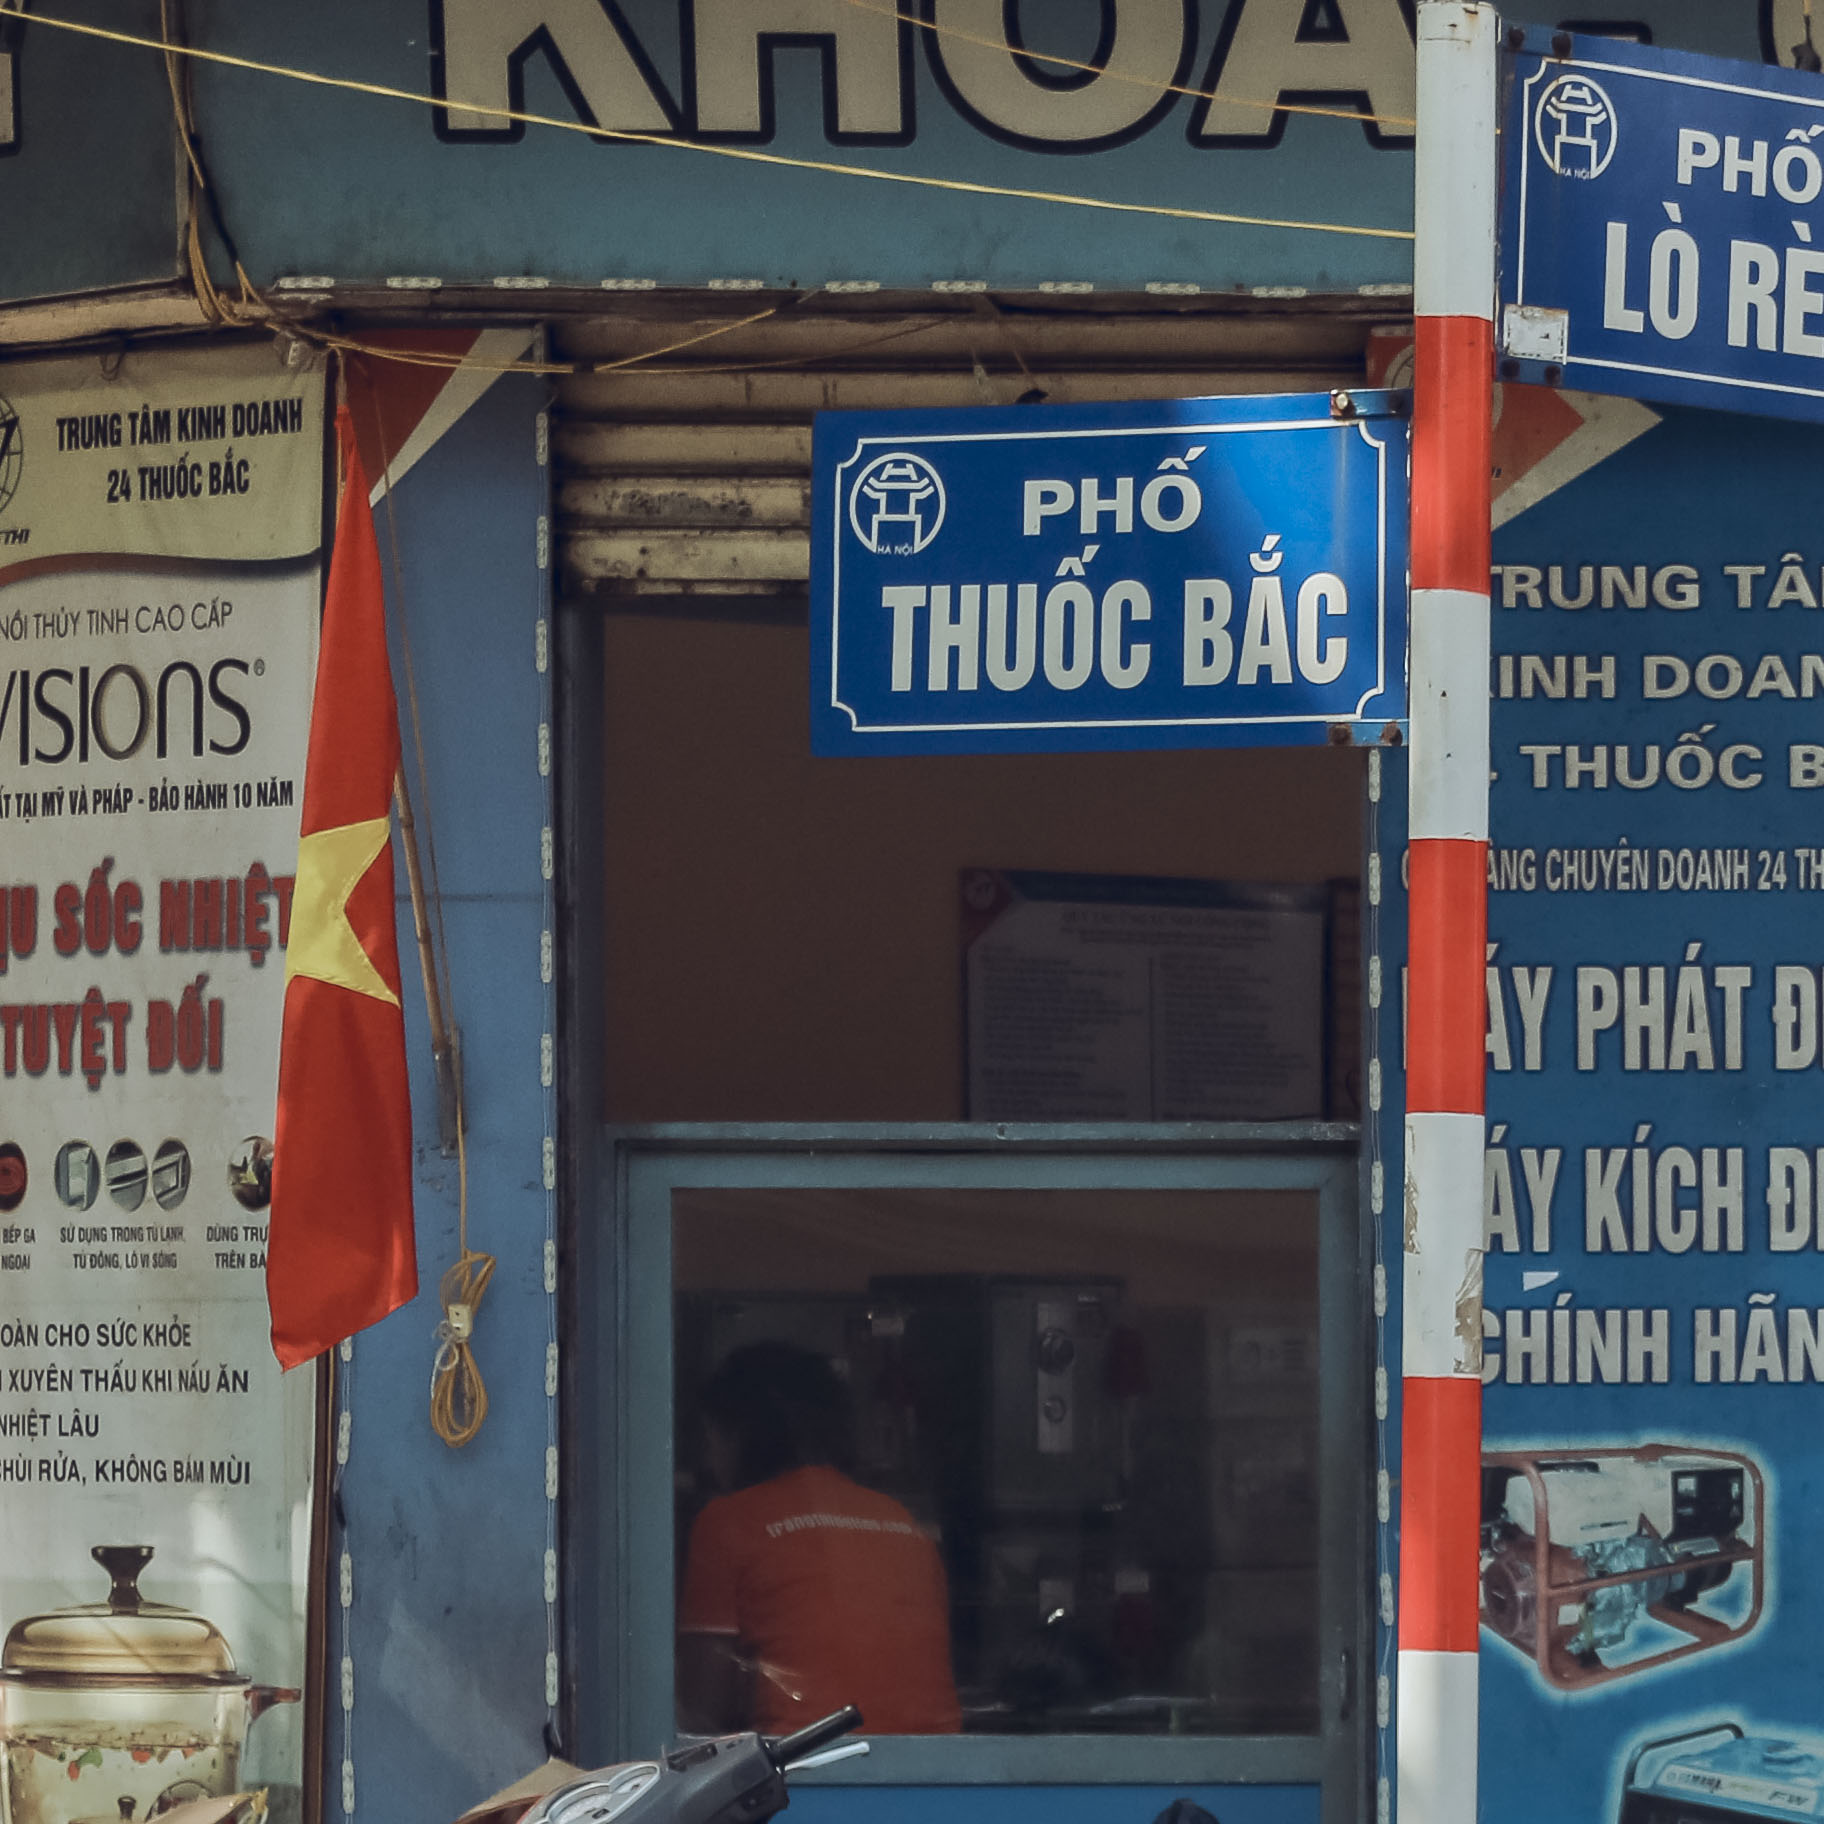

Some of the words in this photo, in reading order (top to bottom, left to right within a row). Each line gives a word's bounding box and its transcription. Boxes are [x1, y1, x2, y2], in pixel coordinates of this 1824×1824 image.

[1603, 201, 1700, 340] LÒ
[56, 412, 122, 451] TRUNG
[128, 403, 171, 446] TÂM
[177, 404, 226, 442] KINH
[232, 396, 303, 437] DOANH
[106, 468, 131, 503] 24
[138, 451, 203, 502] THUỐC
[208, 446, 250, 496] BẮC
[1022, 446, 1208, 536] PHỐ
[32, 606, 81, 639] THỦY
[87, 607, 129, 636] TINH
[135, 602, 185, 633] CAO
[191, 595, 233, 631] CẤP
[881, 544, 1152, 693] THUỐC
[1183, 534, 1349, 686] BẮC
[1490, 655, 1617, 699] INH
[1519, 724, 1764, 789] THUỐC
[15, 791, 37, 823] TẠI
[69, 784, 88, 816] VÀ
[93, 782, 134, 815] PHÁP
[149, 776, 180, 812] BẢO
[184, 780, 228, 811] HÀNH
[233, 782, 251, 809] 10
[257, 776, 294, 807] NĂM
[1486, 838, 1535, 892] ÀNG
[1545, 836, 1649, 892] CHUYÊN
[1657, 848, 1750, 892] DOANH
[1757, 849, 1788, 891] 24
[53, 855, 145, 958] SỐC
[158, 860, 297, 968] NHIỆT
[1485, 942, 1553, 1071] ÁY
[1576, 942, 1753, 1071] PHÁT
[0, 986, 132, 1093] TUYỆT
[1483, 1124, 1561, 1254] ÁY
[1585, 1124, 1744, 1254] KÍCH
[78, 1227, 107, 1247] DỤNG
[110, 1226, 144, 1243] TRONG
[214, 1250, 246, 1270] TRÊN
[0, 1318, 39, 1348] OÀN
[45, 1323, 90, 1347] CHO
[96, 1316, 138, 1348] SỨC
[143, 1313, 192, 1348] KHỎE
[9, 1362, 73, 1393] XUYÊN
[80, 1357, 137, 1393] THẤU
[142, 1368, 172, 1392] KHI
[178, 1359, 211, 1393] NẤU
[216, 1362, 249, 1393] ĂN
[58, 1407, 100, 1437] LÂU
[95, 1453, 168, 1484] KHÔNG
[210, 1454, 251, 1485] MÙI
